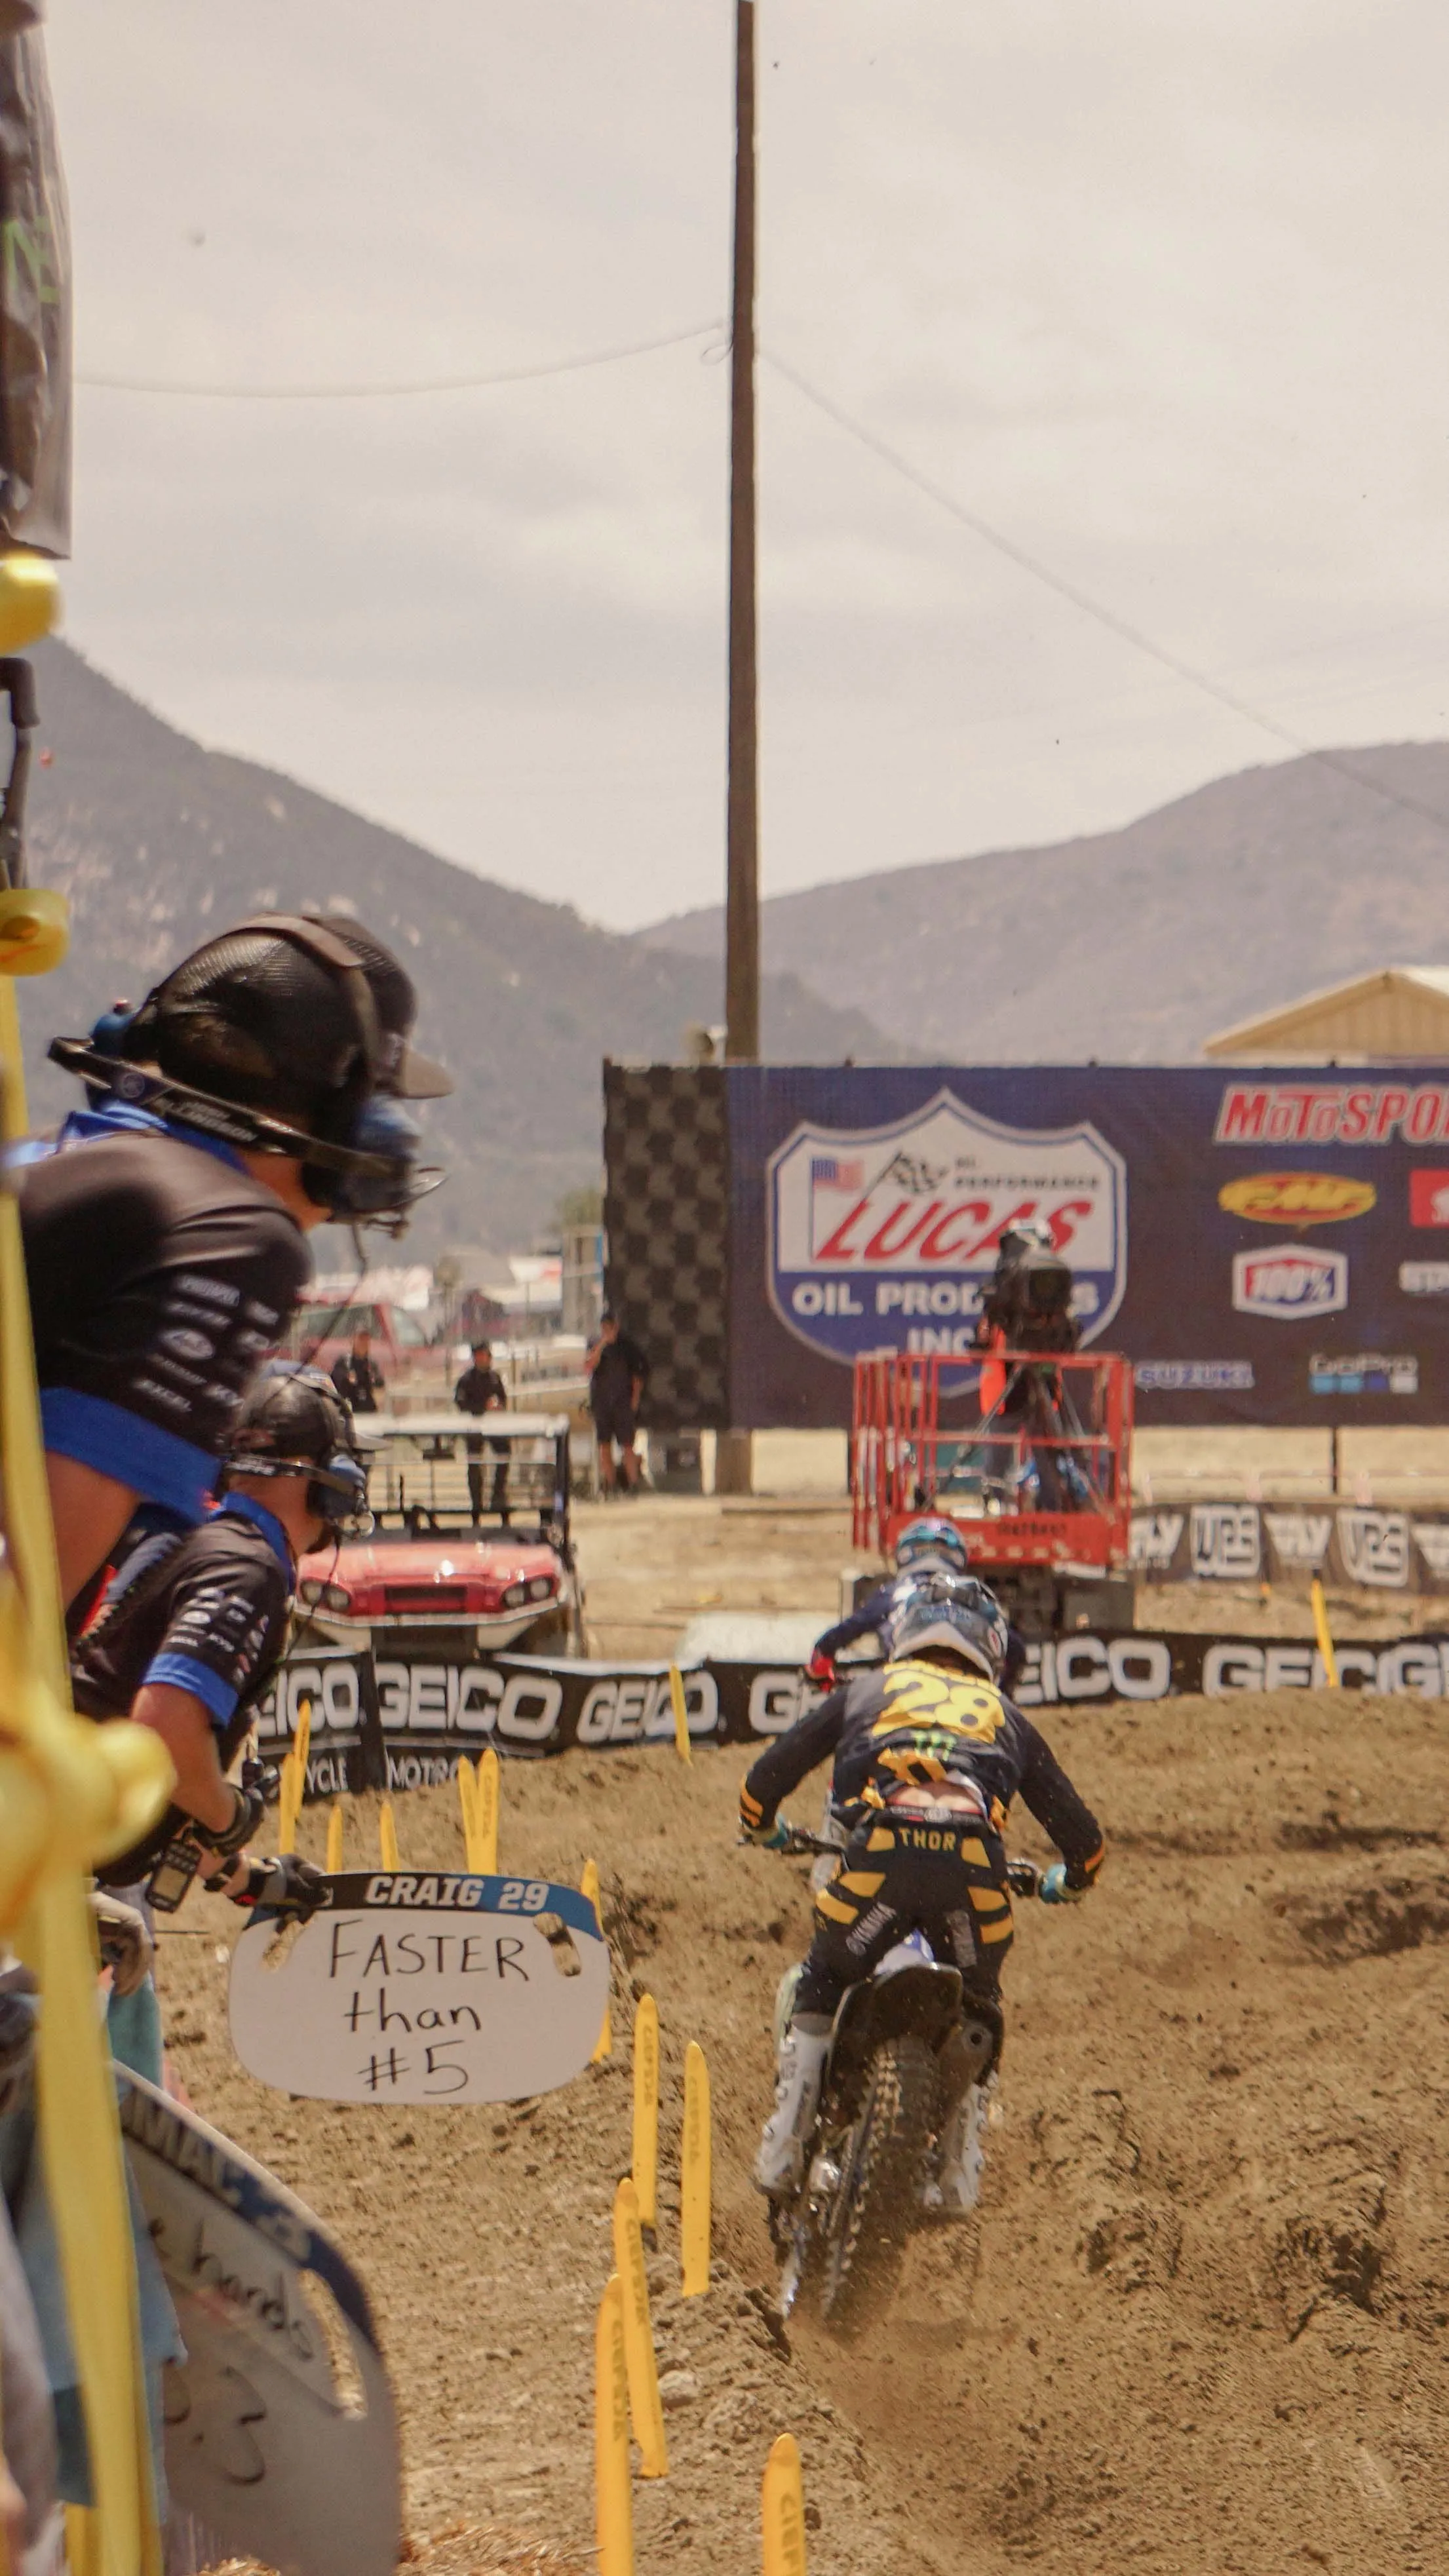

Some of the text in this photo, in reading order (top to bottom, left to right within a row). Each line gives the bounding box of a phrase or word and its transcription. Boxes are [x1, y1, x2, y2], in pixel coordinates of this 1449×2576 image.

[1215, 1085, 1449, 1144] MOTOSPO
[814, 1201, 1092, 1262] LUCAS
[792, 1282, 1100, 1316] OIL PRODS
[374, 1661, 562, 1740] GEICO
[576, 1670, 718, 1742] GEICO
[872, 1668, 1006, 1744] 28
[898, 1827, 957, 1851] THOR
[365, 1875, 549, 1911] CRAIG 29
[330, 1919, 530, 1981] FASTER
[343, 1987, 482, 2033] than
[357, 2039, 469, 2095] #5
